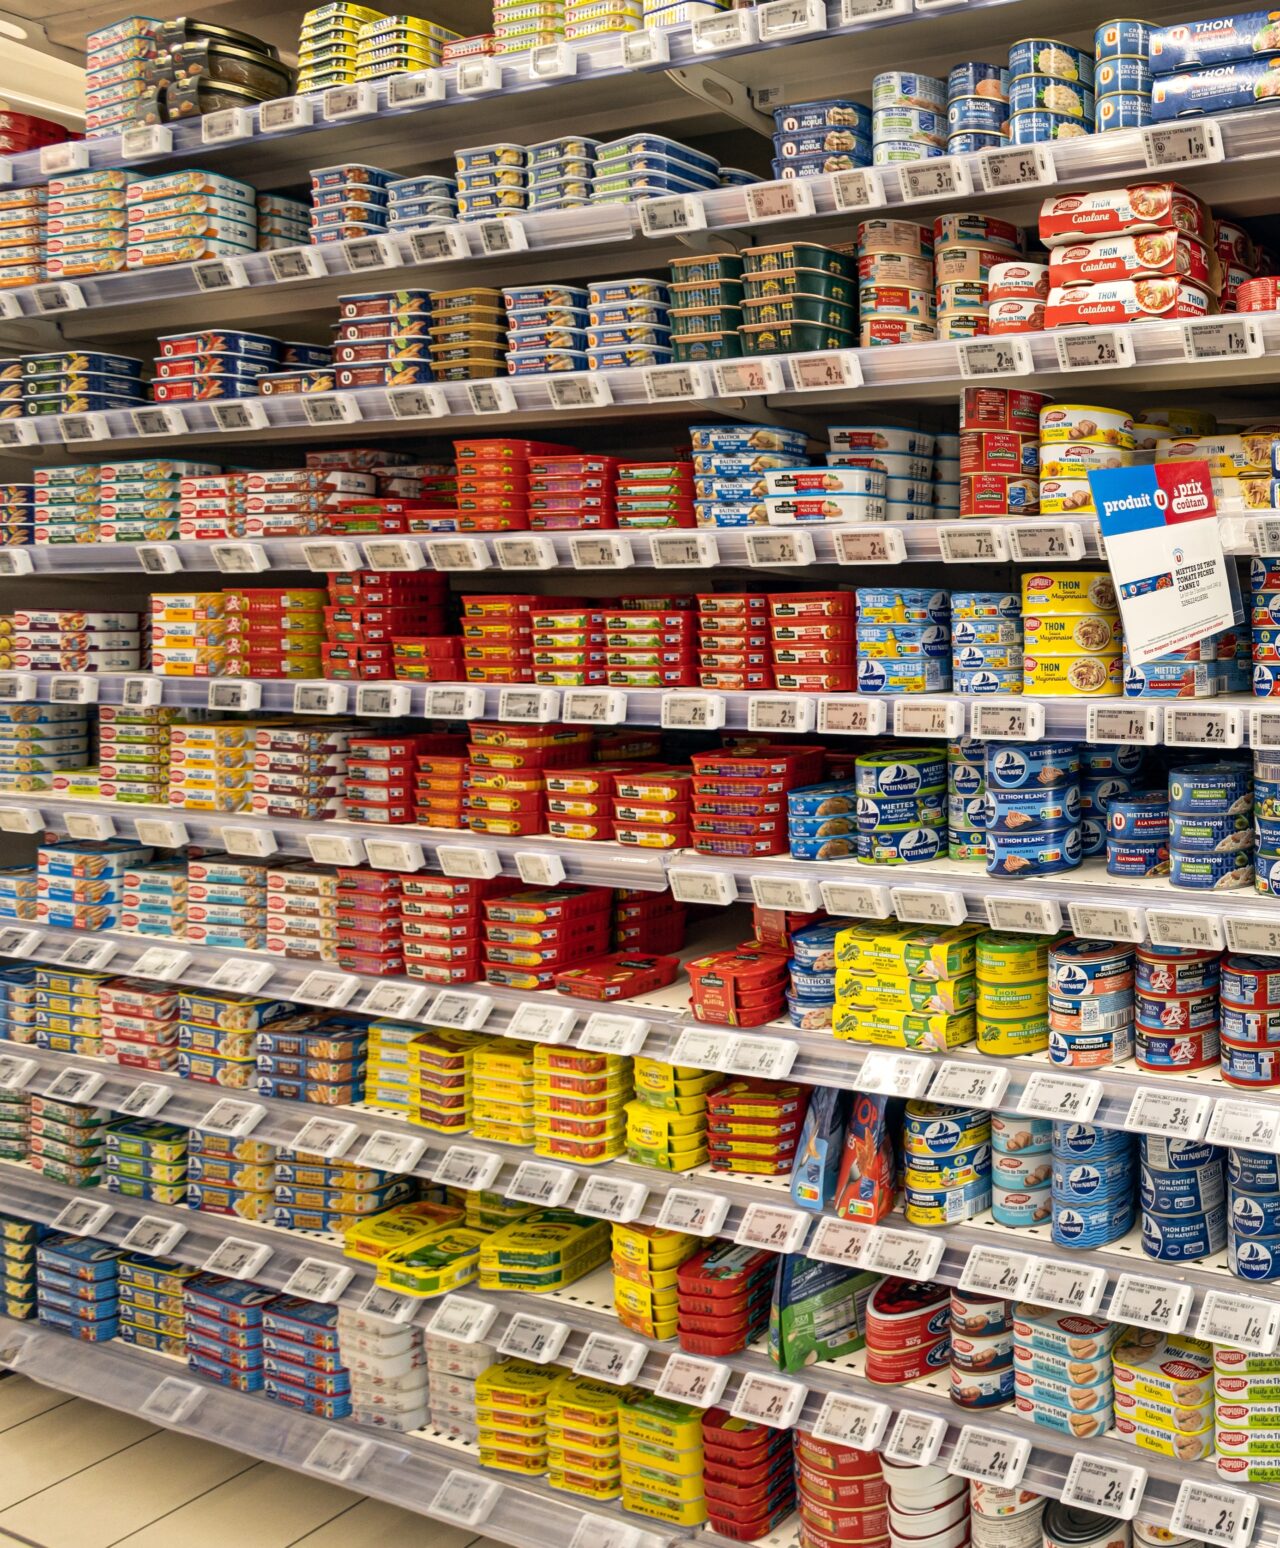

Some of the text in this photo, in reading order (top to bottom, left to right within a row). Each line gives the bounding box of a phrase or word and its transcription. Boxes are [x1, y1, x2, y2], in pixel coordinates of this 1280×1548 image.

[1092, 200, 1111, 209] THON
[1072, 213, 1110, 224] Catalane
[1100, 247, 1117, 257] THON
[1081, 262, 1116, 272] Catalane
[1098, 291, 1117, 299] THON
[1078, 305, 1115, 315] Catalane
[1103, 480, 1203, 516] produit U à prix
[1177, 497, 1205, 510] coûtant
[1175, 565, 1197, 576] MIETTES
[1204, 560, 1216, 569] THON
[1177, 574, 1197, 584] TOMATE
[1058, 581, 1080, 589] THON
[1178, 582, 1194, 592] CANNE
[881, 801, 914, 810] MIETTES
